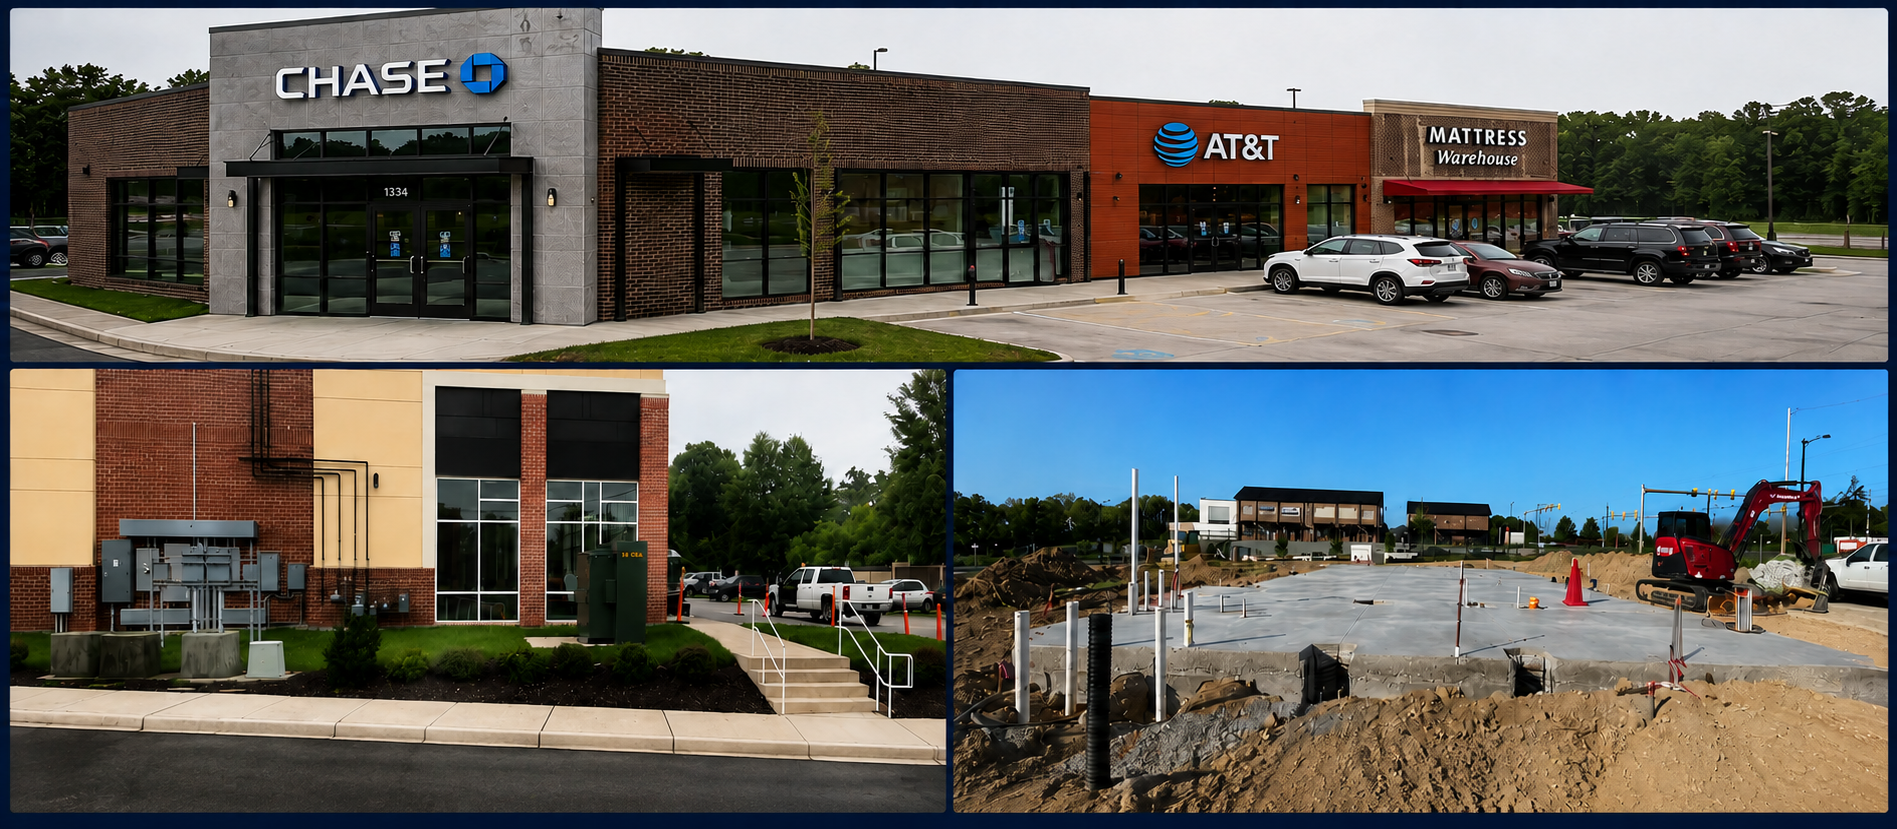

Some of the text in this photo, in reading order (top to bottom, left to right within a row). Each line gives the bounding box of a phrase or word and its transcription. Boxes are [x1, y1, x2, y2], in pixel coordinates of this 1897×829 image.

[275, 58, 452, 100] CHASE
[1429, 126, 1527, 146] MATTRESS
[1203, 132, 1280, 161] AT&T
[1437, 149, 1518, 166] Warehouse
[383, 187, 408, 197] 1334
